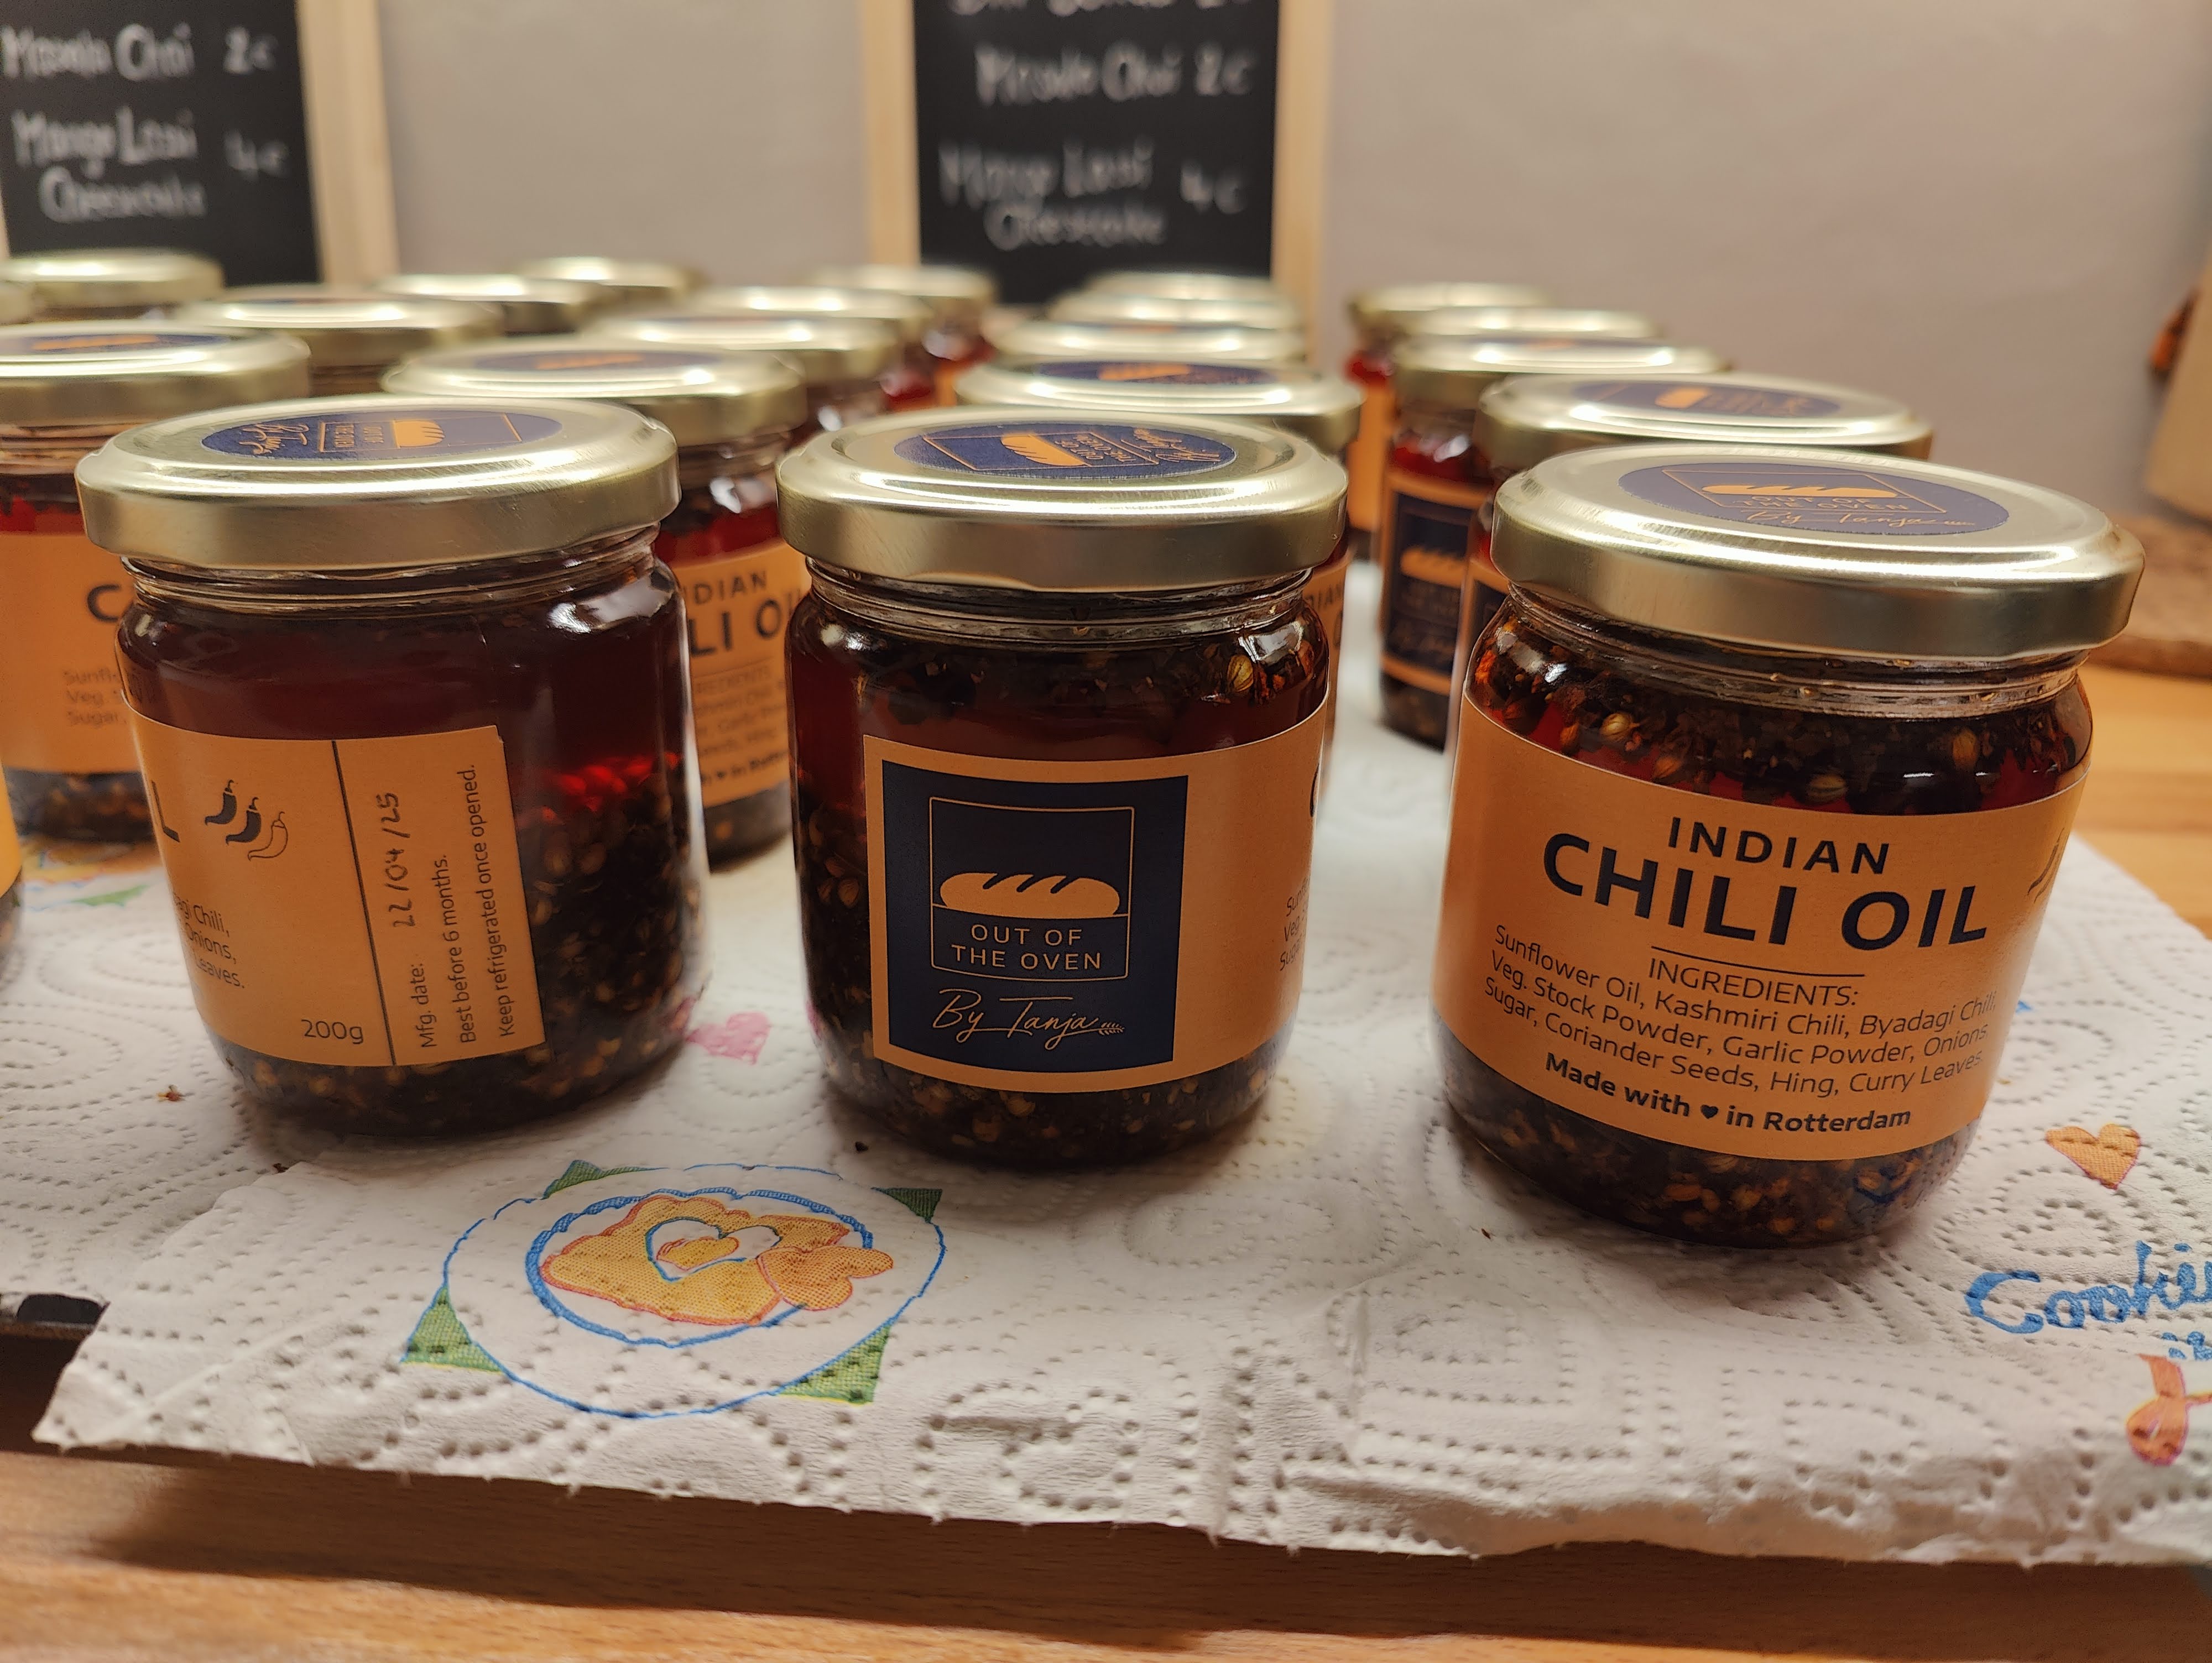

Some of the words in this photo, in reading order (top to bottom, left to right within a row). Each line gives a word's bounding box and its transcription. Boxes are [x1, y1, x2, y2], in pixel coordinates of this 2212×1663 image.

[457, 763, 488, 837] opened.
[473, 842, 492, 885] once
[1668, 817, 1890, 875] INDIAN
[432, 854, 456, 927] months.
[1543, 833, 1797, 945] CHILI
[1841, 885, 1987, 950] OIL
[193, 904, 230, 938] Chili,
[442, 930, 460, 942] 6
[476, 888, 508, 993] refrigerated
[971, 924, 1031, 946] OUT
[1045, 928, 1082, 946] OF
[448, 946, 471, 1006] before
[951, 944, 1006, 968] THE
[1020, 951, 1101, 970] OVEN
[1495, 924, 1599, 989] Sunflower
[1606, 976, 1645, 1010] Oil,
[1655, 992, 1777, 1032] Kashmiri
[1787, 1014, 1850, 1038] Chili,
[1860, 1005, 1956, 1038] Byadagi
[1648, 958, 1858, 1007] INGREDIENTS:
[411, 963, 430, 1006] date:
[1492, 950, 1527, 990] Veg.
[1533, 975, 1595, 1018] Stock
[1603, 1005, 1713, 1055] Powder,
[1723, 1035, 1804, 1065] Garlic
[1811, 1041, 1915, 1065] Powder,
[301, 1019, 364, 1045] 200g
[420, 1010, 437, 1048] Mfg.
[460, 1008, 477, 1043] Best
[499, 996, 516, 1039] Keep
[932, 989, 999, 1043] By
[999, 996, 1100, 1050] Tanja
[1485, 976, 1538, 1027] Sugar,
[1545, 1012, 1664, 1070] Coriander
[1670, 1055, 1760, 1092] Seeds,
[1770, 1071, 1838, 1097] Hing,
[1849, 1071, 1916, 1092] Curry
[1545, 1053, 1616, 1096] Made
[1624, 1085, 1690, 1117] with
[1725, 1106, 1754, 1128] in
[1763, 1110, 1911, 1133] Rotterdam
